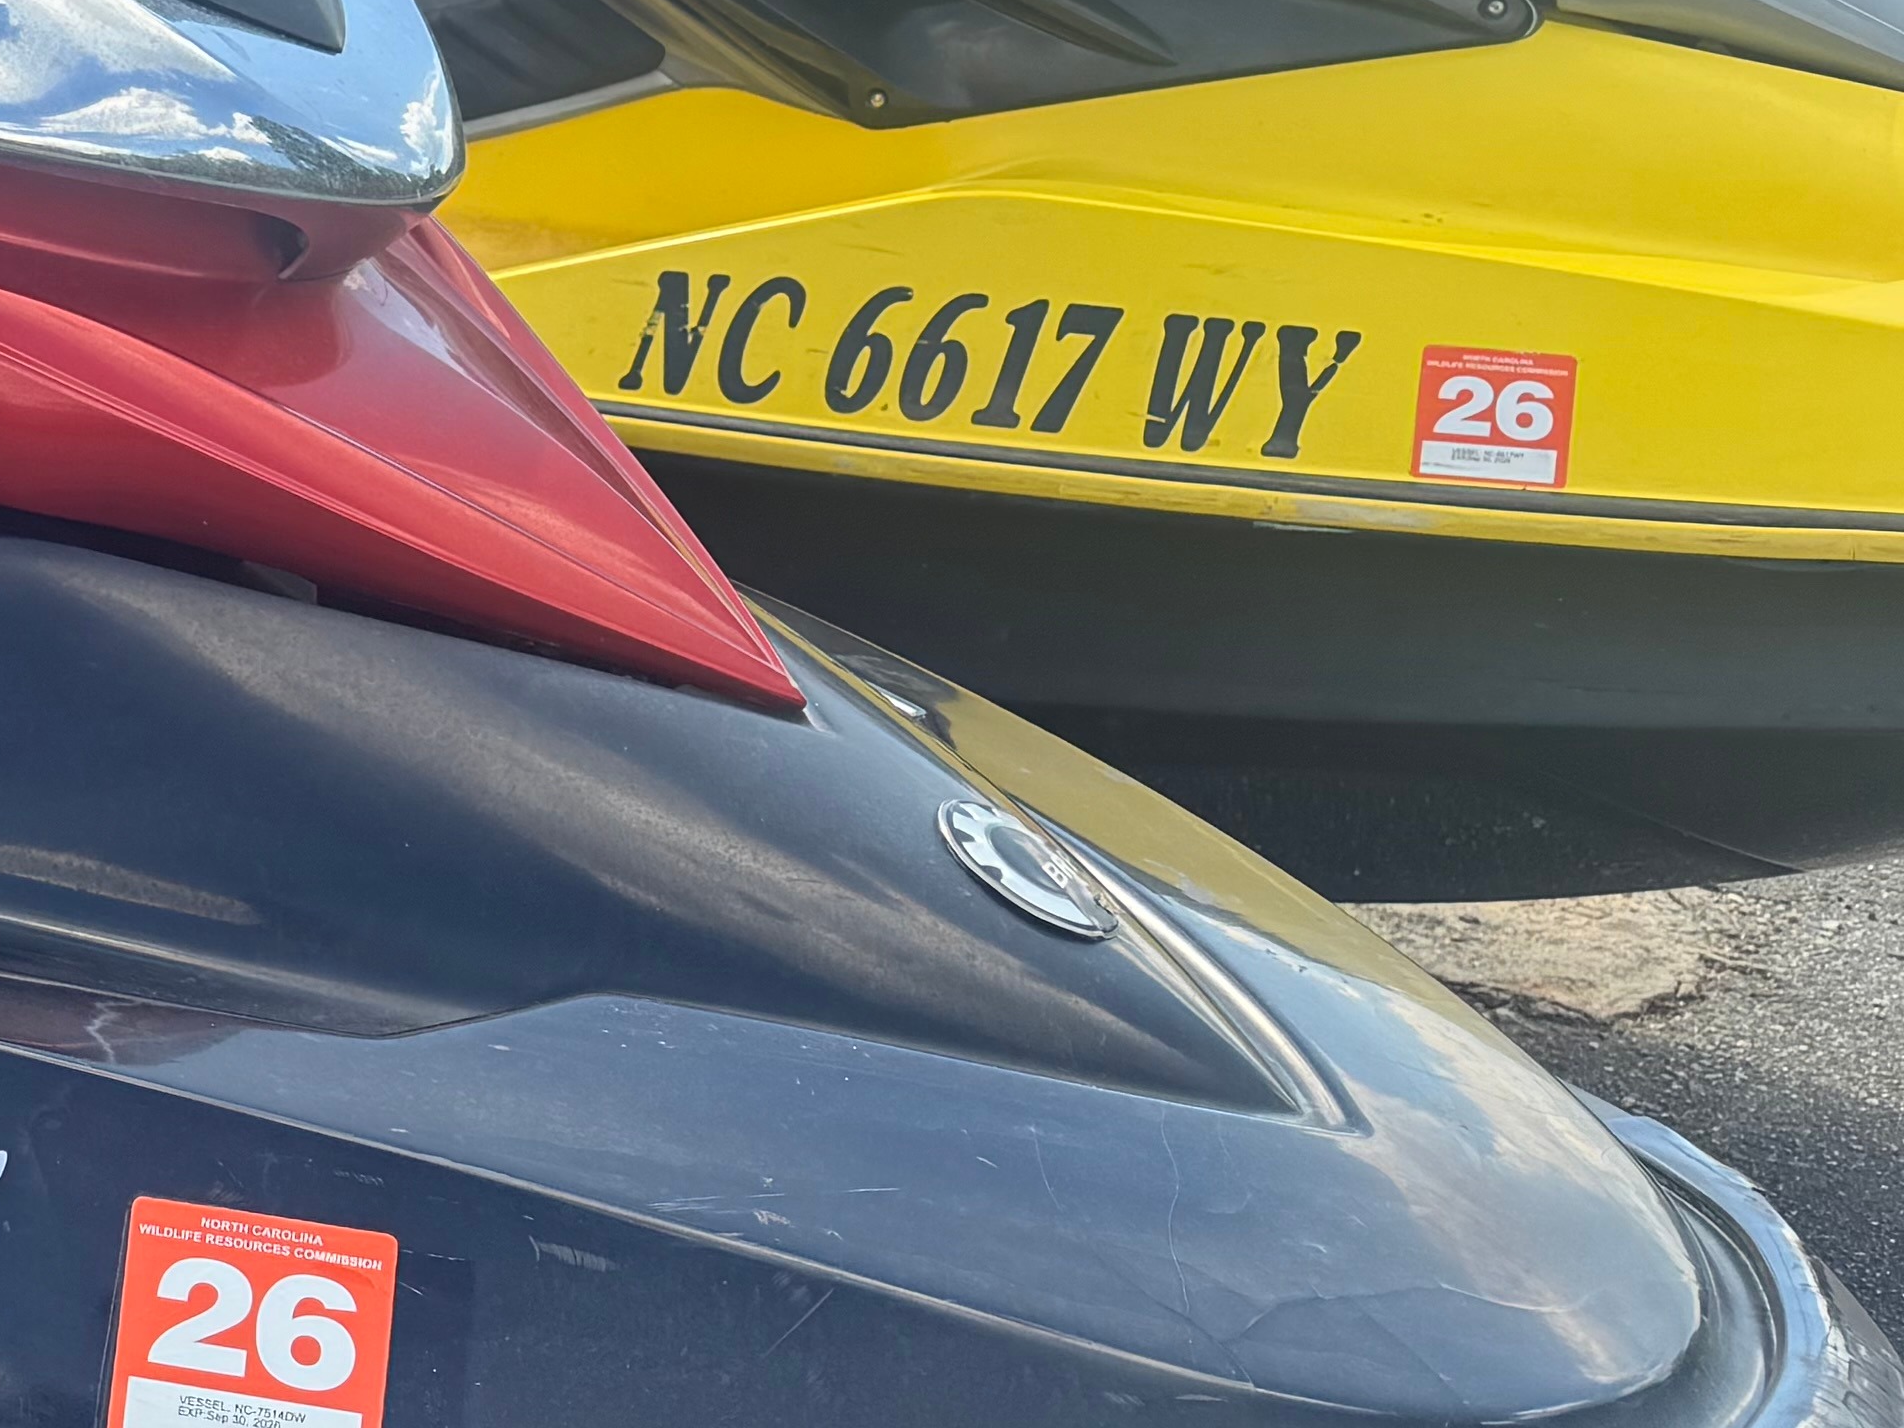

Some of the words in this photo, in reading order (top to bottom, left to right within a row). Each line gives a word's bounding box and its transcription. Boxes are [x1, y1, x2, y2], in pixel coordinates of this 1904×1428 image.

[618, 270, 806, 404] NC
[824, 285, 1124, 433] 6617
[1142, 313, 1362, 459] WY
[1432, 375, 1555, 442] 26
[138, 1222, 202, 1243] WILDLIFE
[205, 1232, 291, 1257] RESOURCES
[294, 1247, 383, 1271] COMMISSION
[200, 1216, 249, 1235] NORTH
[252, 1224, 324, 1247] CAROLINA
[147, 1256, 358, 1392] 26
